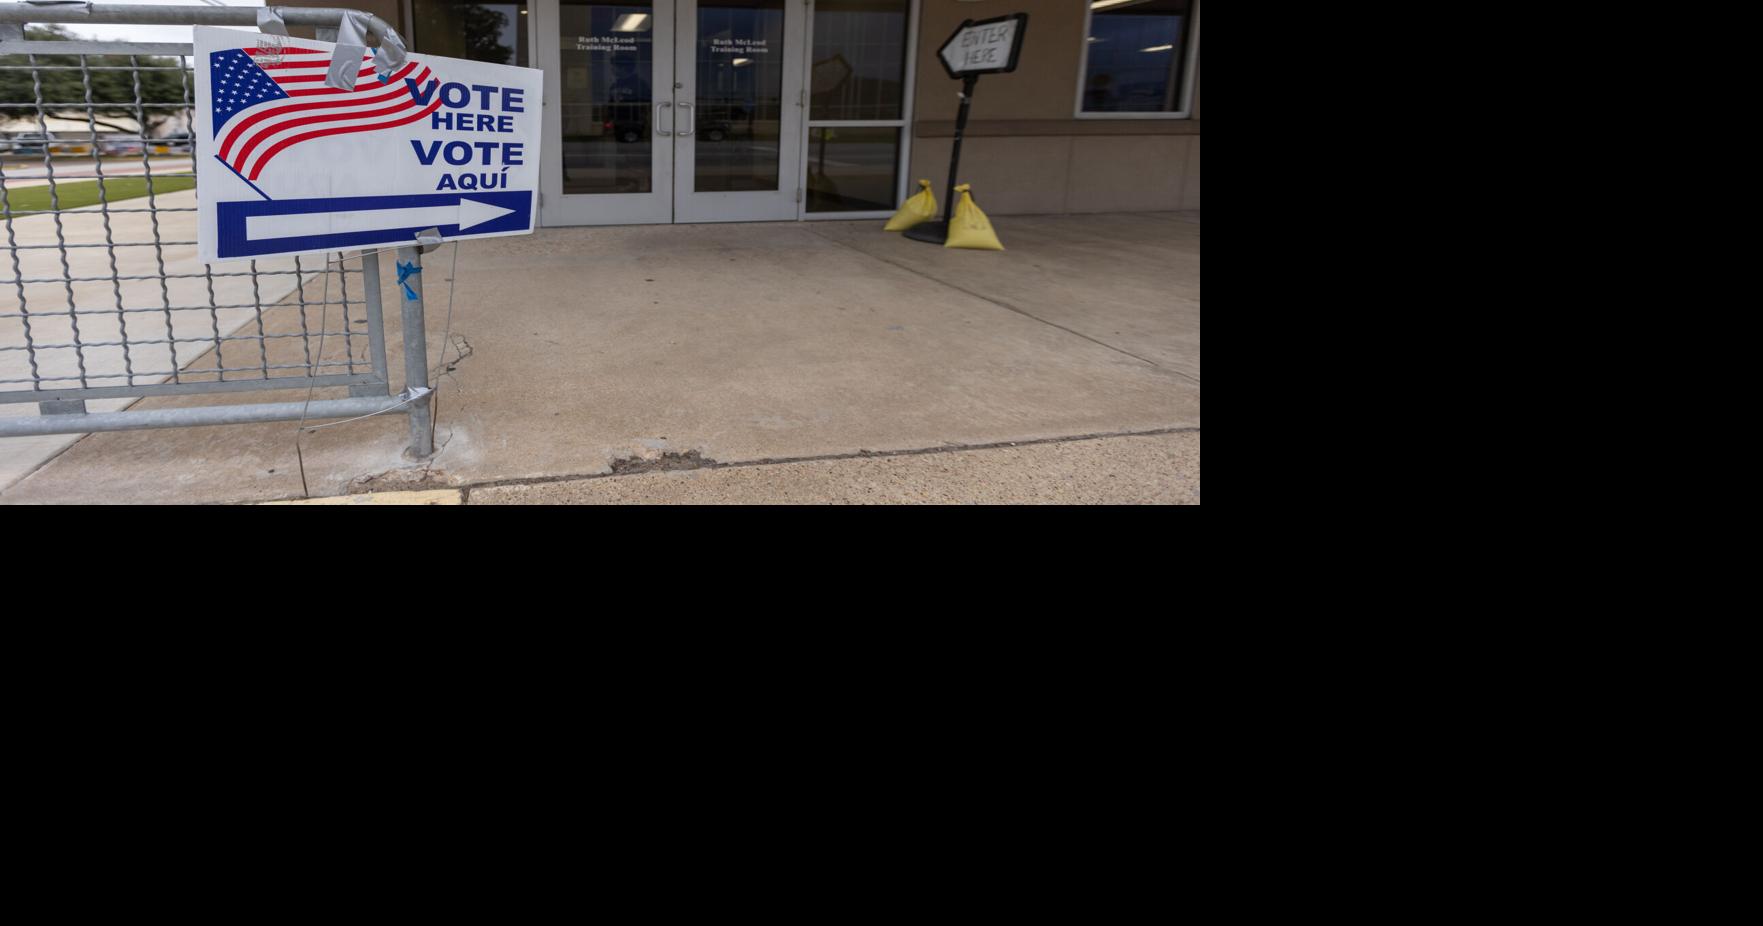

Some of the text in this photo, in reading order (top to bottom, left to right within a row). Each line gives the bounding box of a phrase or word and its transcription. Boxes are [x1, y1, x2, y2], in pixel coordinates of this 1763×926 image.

[602, 36, 635, 44] McLeod
[961, 24, 1009, 48] ENTER
[576, 44, 611, 52] Training
[710, 46, 744, 54] Training
[963, 47, 997, 65] HERE
[404, 78, 524, 113] VOTE
[432, 112, 514, 133] HERE
[410, 140, 524, 166] VOTE
[436, 166, 510, 191] AQUÍ
